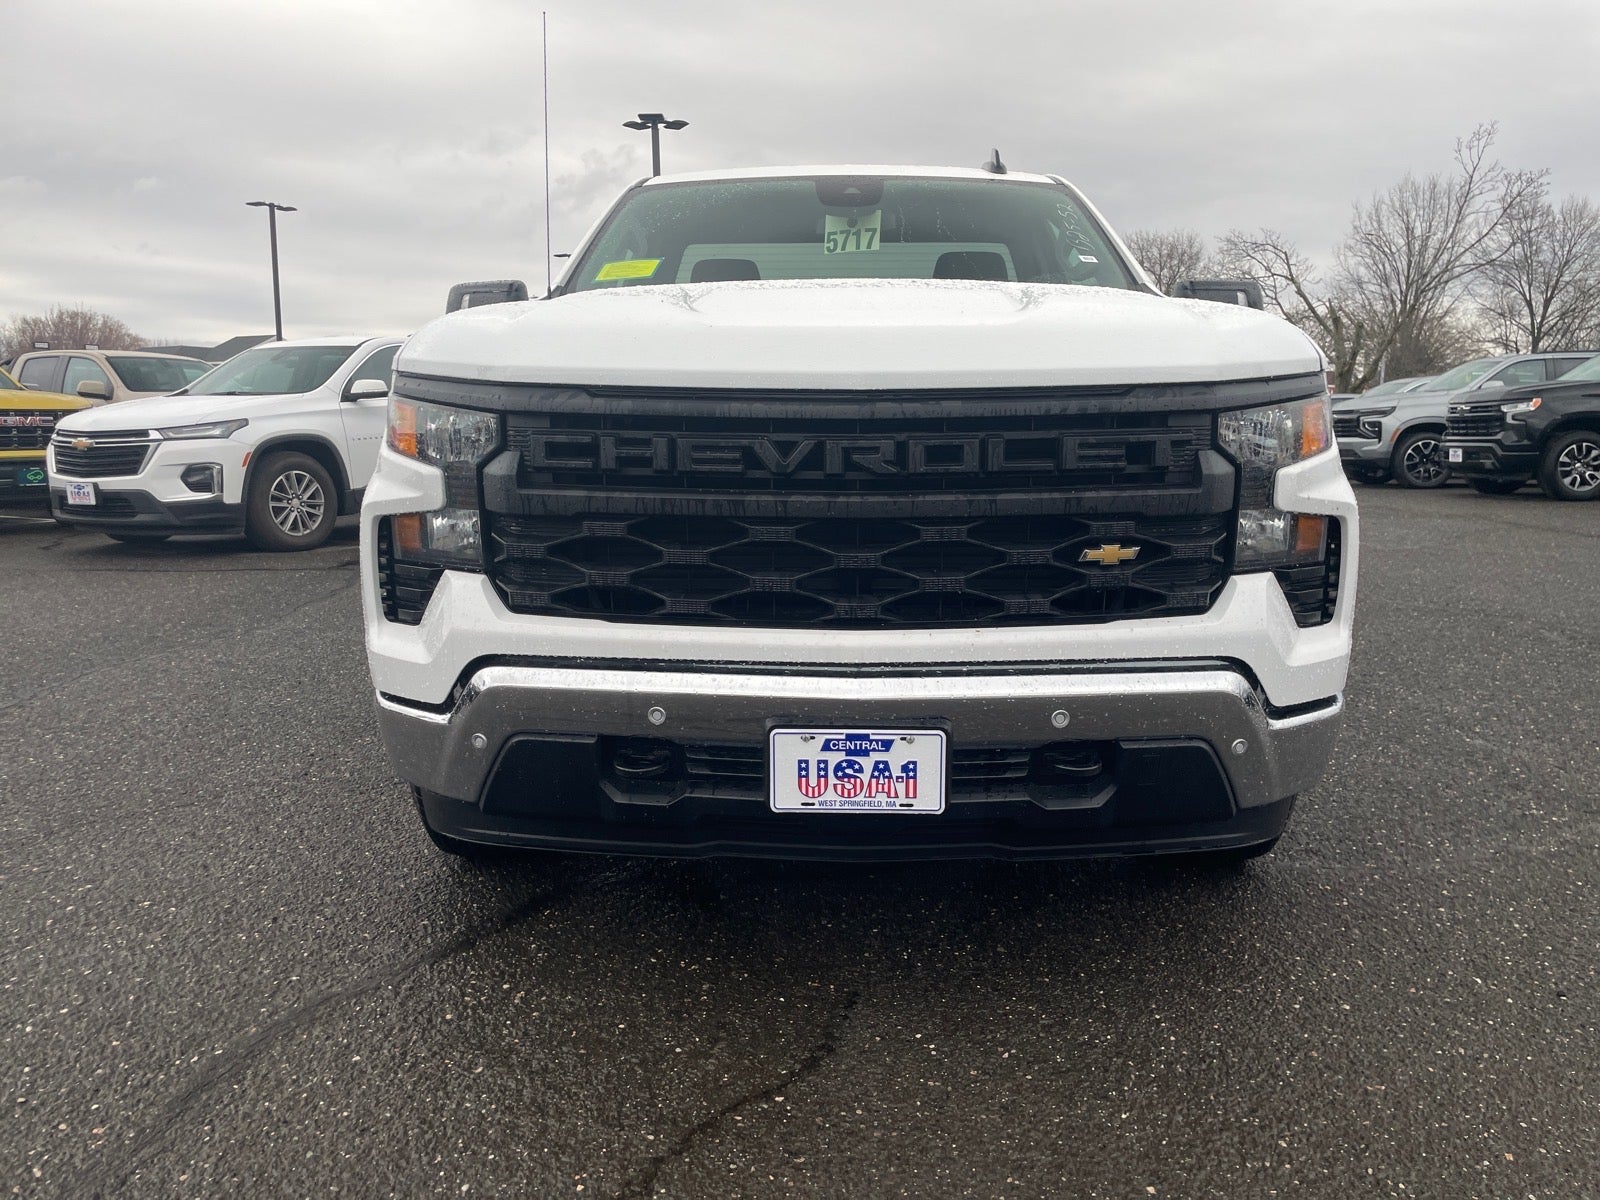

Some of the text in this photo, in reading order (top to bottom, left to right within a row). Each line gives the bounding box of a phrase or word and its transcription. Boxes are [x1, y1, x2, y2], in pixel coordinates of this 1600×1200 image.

[825, 228, 878, 253] 5717
[0, 416, 54, 426] GMC
[530, 432, 1195, 475] CHEVROLET
[830, 741, 886, 750] CENTRAL
[797, 759, 918, 799] USA-1
[818, 800, 837, 808] WEST
[838, 800, 884, 808] SPRINGFIELD,
